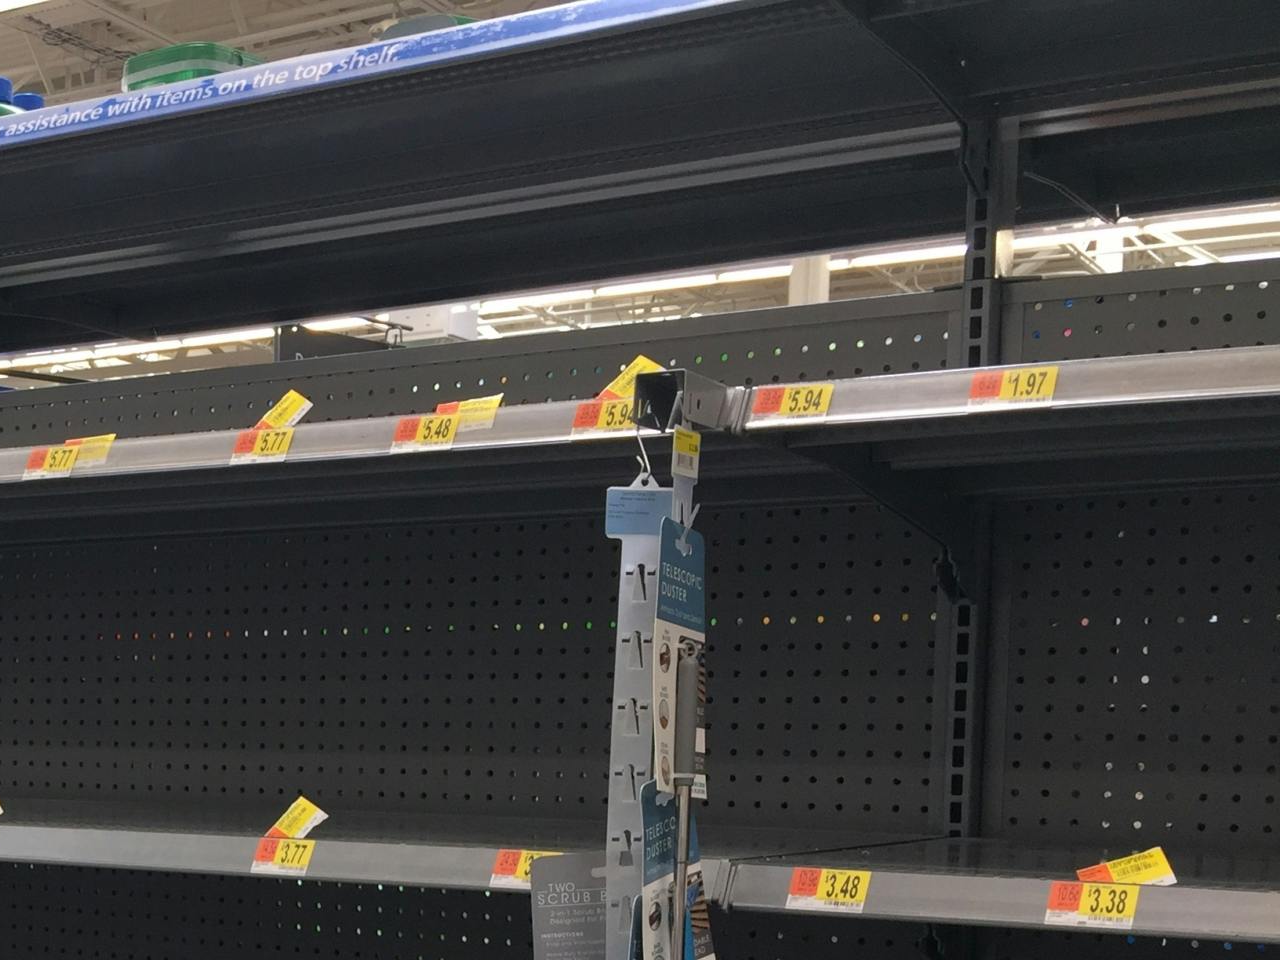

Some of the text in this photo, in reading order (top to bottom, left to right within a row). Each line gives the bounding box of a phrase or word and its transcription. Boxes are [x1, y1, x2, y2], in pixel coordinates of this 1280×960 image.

[5, 107, 103, 138] assistance
[106, 96, 151, 118] with
[155, 84, 214, 109] items
[218, 79, 247, 96] on
[252, 70, 289, 90] the
[294, 61, 334, 83] top
[662, 561, 703, 591] TELESCOPIC
[661, 581, 688, 602] DUSTER
[645, 816, 677, 842] TELESCO
[537, 892, 591, 905] SCRUB
[548, 882, 575, 893] TWO
